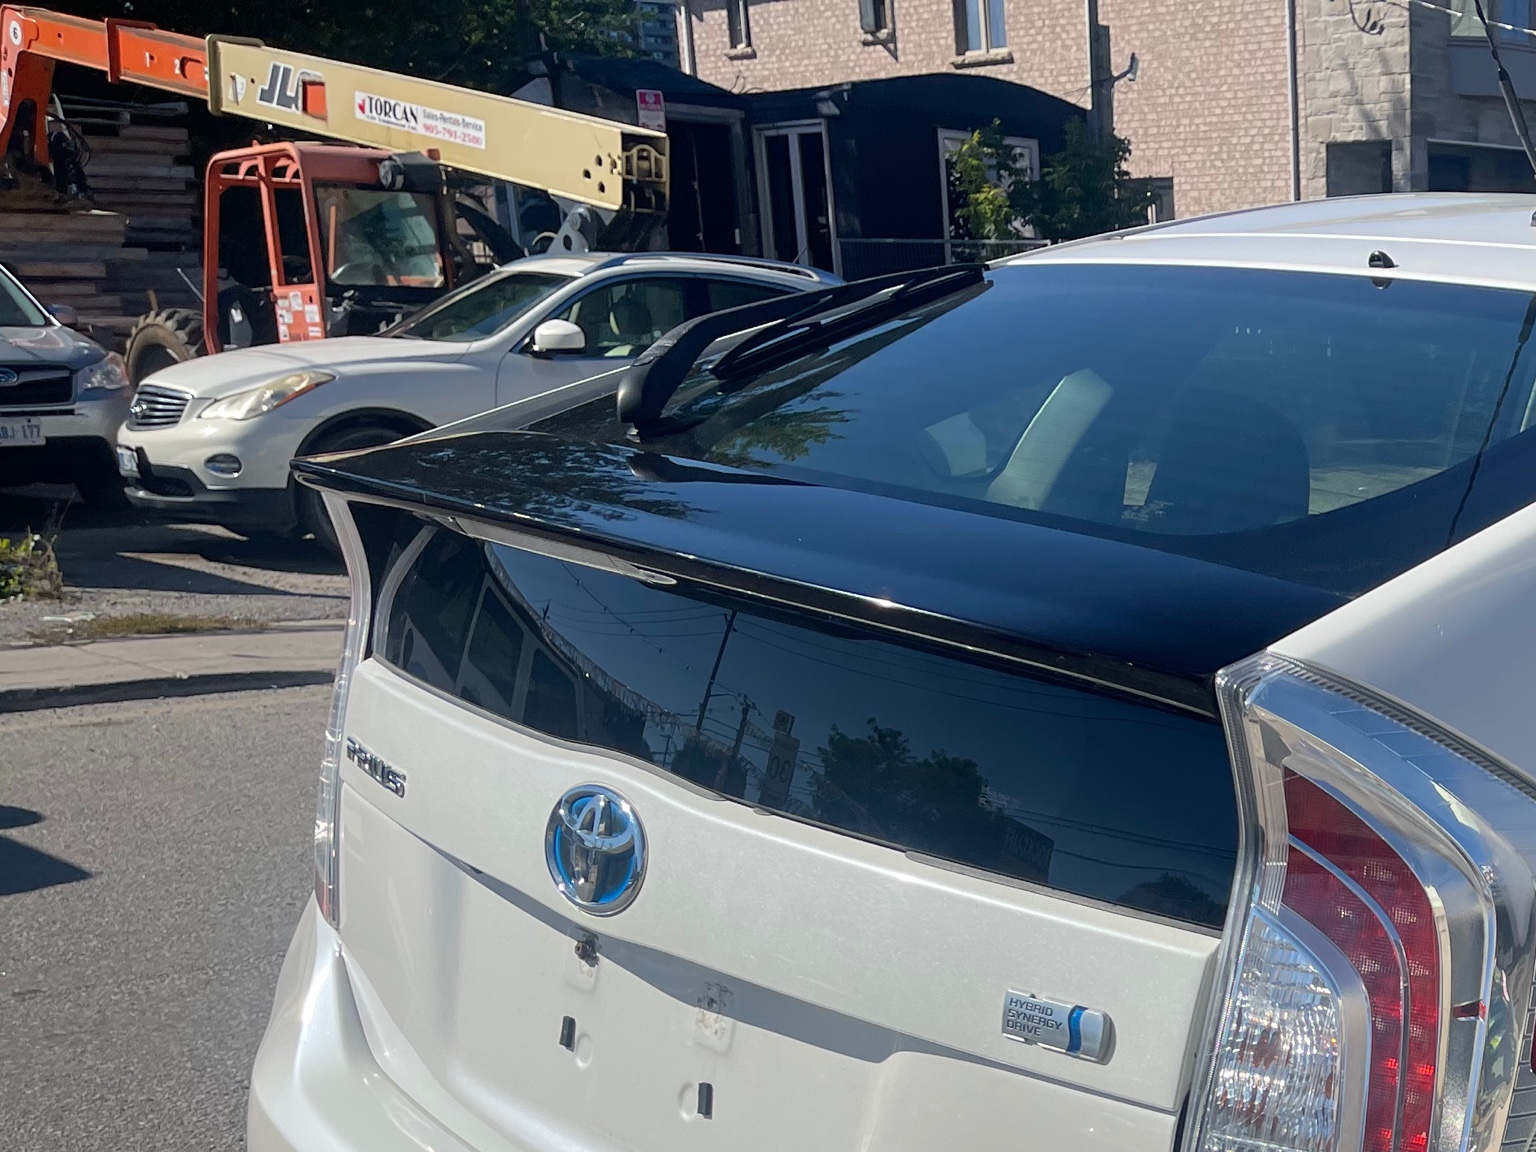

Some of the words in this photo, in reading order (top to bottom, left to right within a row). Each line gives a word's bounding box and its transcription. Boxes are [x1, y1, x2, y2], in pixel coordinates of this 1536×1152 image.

[256, 61, 324, 115] JL
[367, 95, 418, 125] TORCAN
[346, 735, 407, 799] PRIUS
[1007, 1008, 1063, 1030] SYNERGY
[1009, 997, 1054, 1017] HYBRID
[1006, 1019, 1042, 1036] DRIVE
